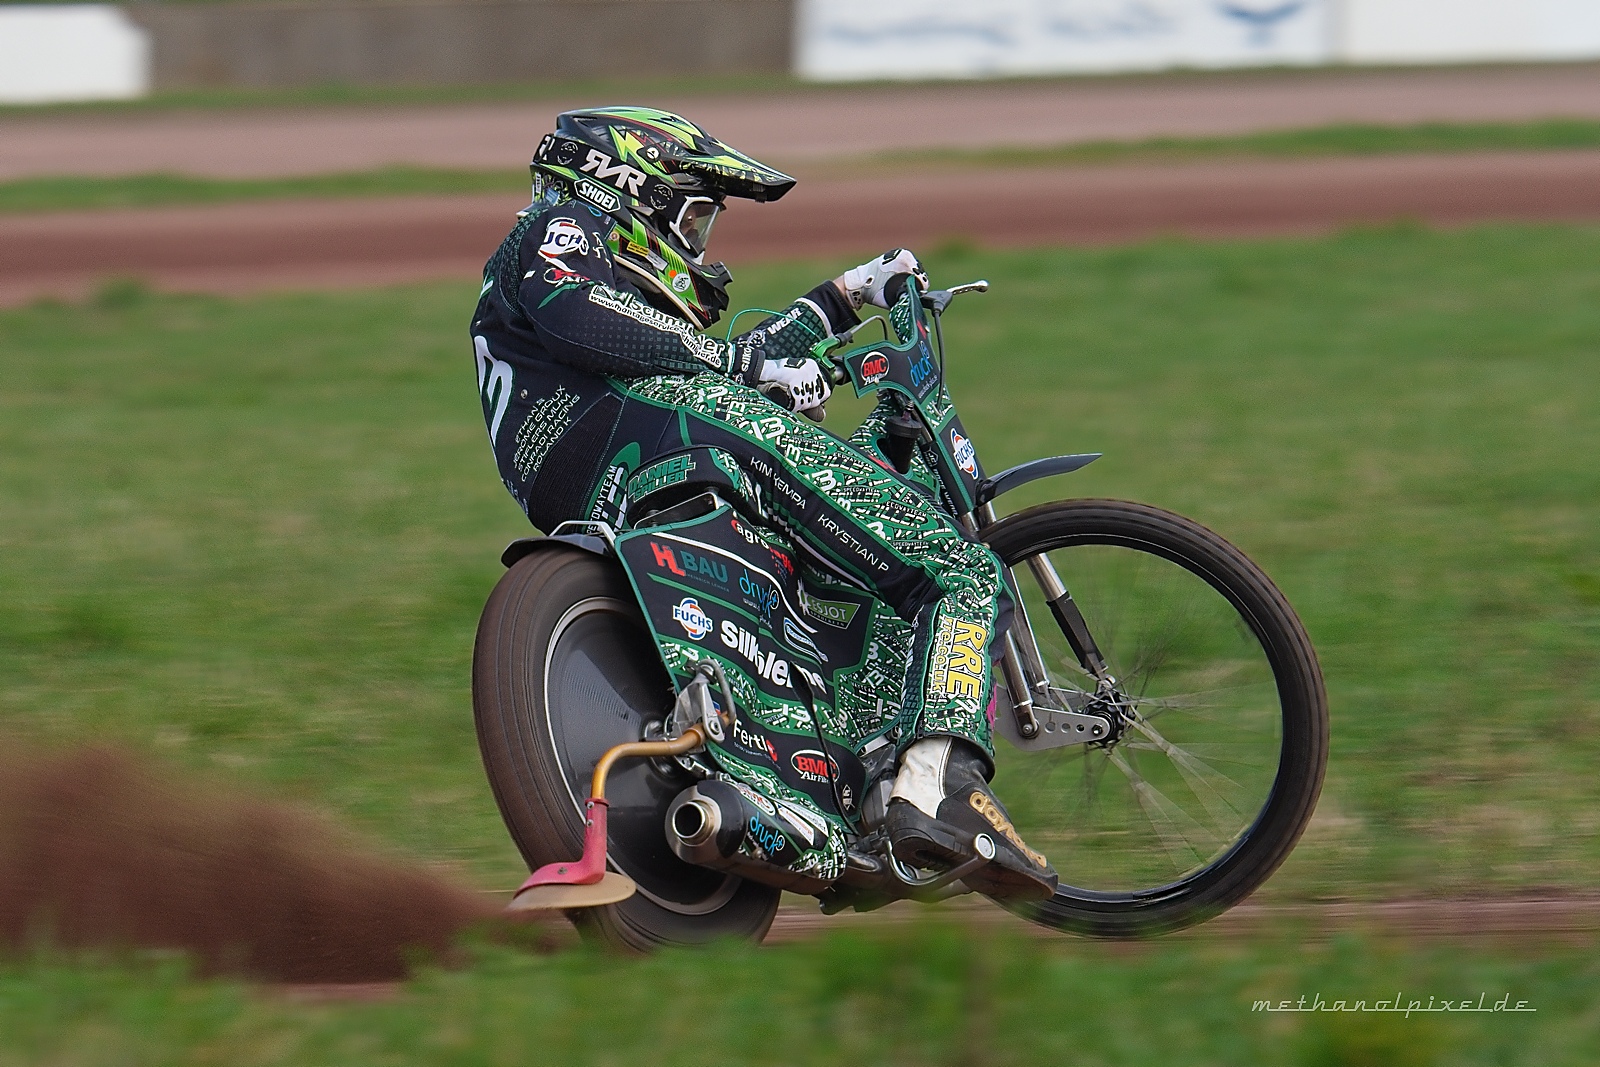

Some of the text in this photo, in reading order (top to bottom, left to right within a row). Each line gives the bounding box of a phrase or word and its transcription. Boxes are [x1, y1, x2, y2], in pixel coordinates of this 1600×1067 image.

[579, 181, 616, 210] SHOEI
[767, 307, 803, 335] WEAR
[863, 357, 887, 377] BMC
[513, 422, 537, 469] JEROME
[518, 420, 548, 472] STIFLERS
[546, 393, 571, 421] MUM
[521, 394, 581, 482] CONRADI RACING
[533, 416, 572, 472] ROLAND K
[629, 456, 694, 492] DANIEL
[750, 456, 774, 478] KIM
[634, 470, 685, 499] SPILLER
[818, 513, 881, 568] KRYSTIAN
[877, 561, 889, 573] P
[680, 550, 728, 583] BAU
[674, 608, 712, 630] FUCHS
[946, 620, 988, 700] RRE
[796, 755, 837, 779] BMC
[800, 771, 819, 782] Air
[749, 811, 779, 856] druck
